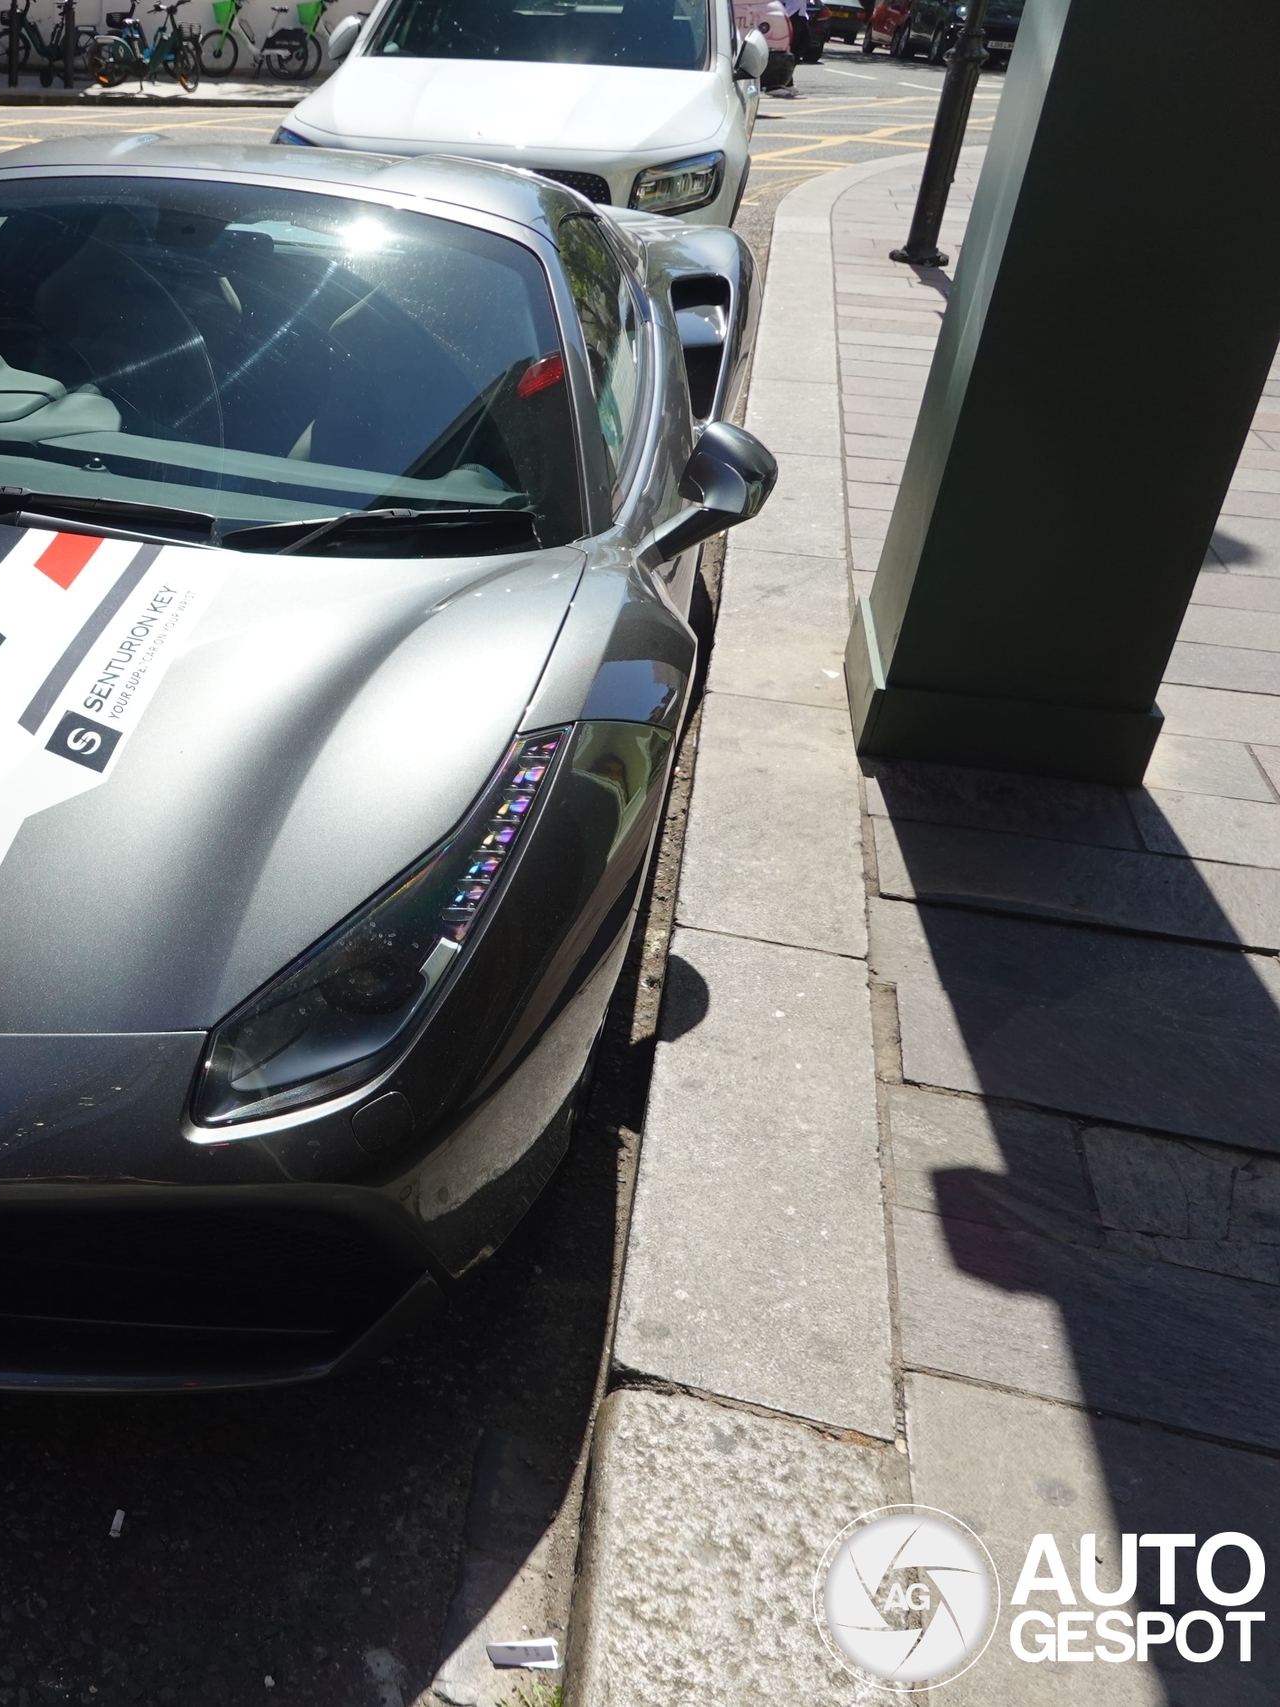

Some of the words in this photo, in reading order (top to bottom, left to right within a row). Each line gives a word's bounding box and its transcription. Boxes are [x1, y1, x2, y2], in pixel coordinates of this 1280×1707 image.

[83, 615, 158, 713] SENTURION
[146, 584, 177, 614] KEY
[108, 691, 132, 720] YOUR
[153, 632, 167, 646] ON
[162, 612, 181, 634] YOUR
[176, 590, 197, 614] WRIST
